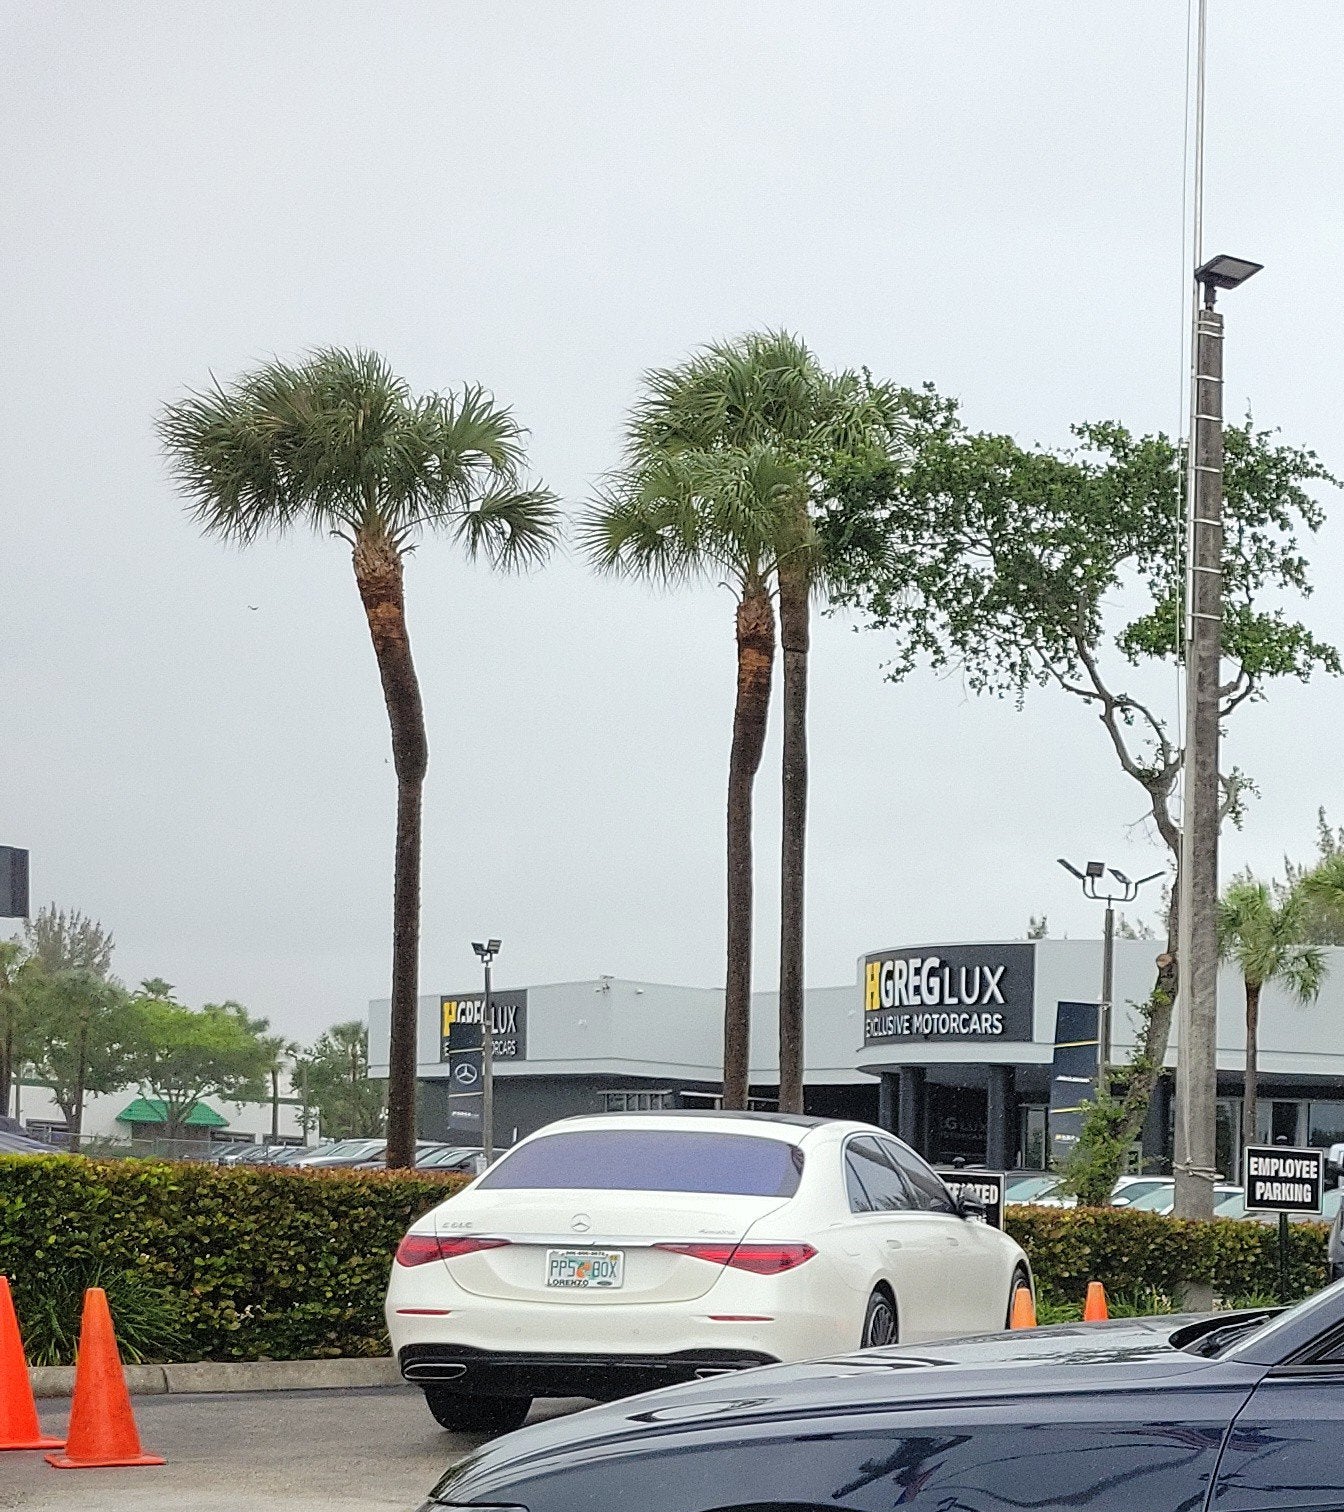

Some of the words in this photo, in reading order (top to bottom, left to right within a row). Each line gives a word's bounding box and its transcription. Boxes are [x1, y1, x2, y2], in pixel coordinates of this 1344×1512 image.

[865, 1014, 911, 1038] EXCLUSIVE
[912, 1012, 1004, 1035] MOTORCARS
[1249, 1156, 1318, 1179] EMPLOYEE
[1255, 1181, 1312, 1203] PARKING
